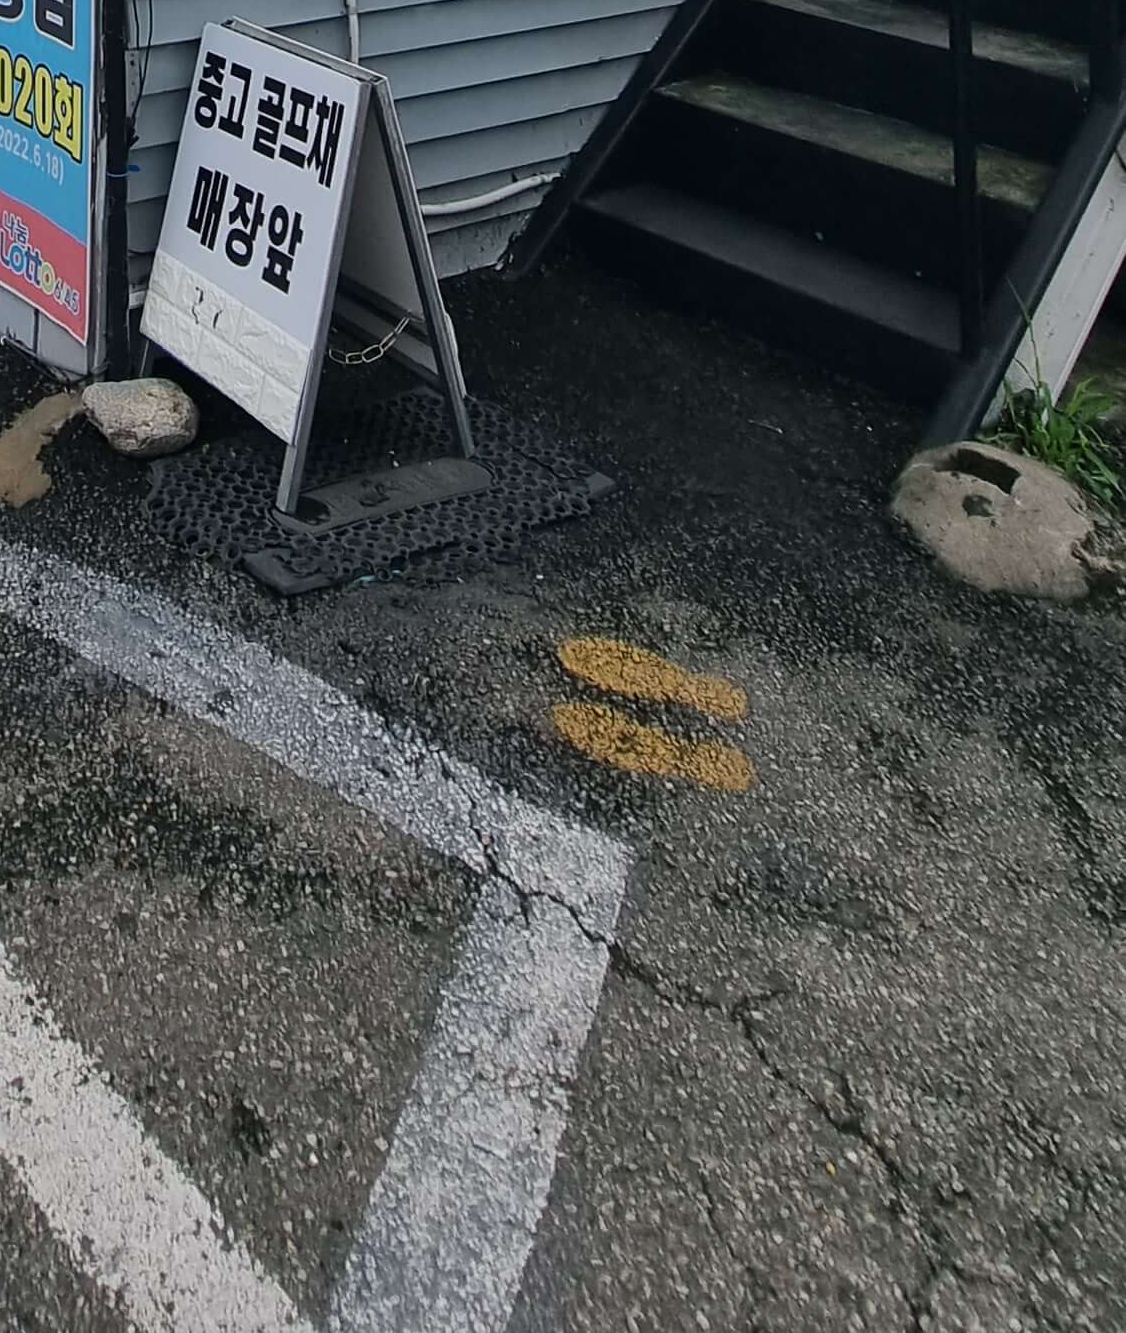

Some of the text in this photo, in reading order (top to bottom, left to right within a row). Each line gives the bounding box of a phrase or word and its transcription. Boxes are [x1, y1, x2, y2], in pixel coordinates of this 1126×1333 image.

[193, 50, 346, 189] 중고 골프채
[1, 210, 28, 248] 나눔
[186, 165, 304, 295] 매장앞
